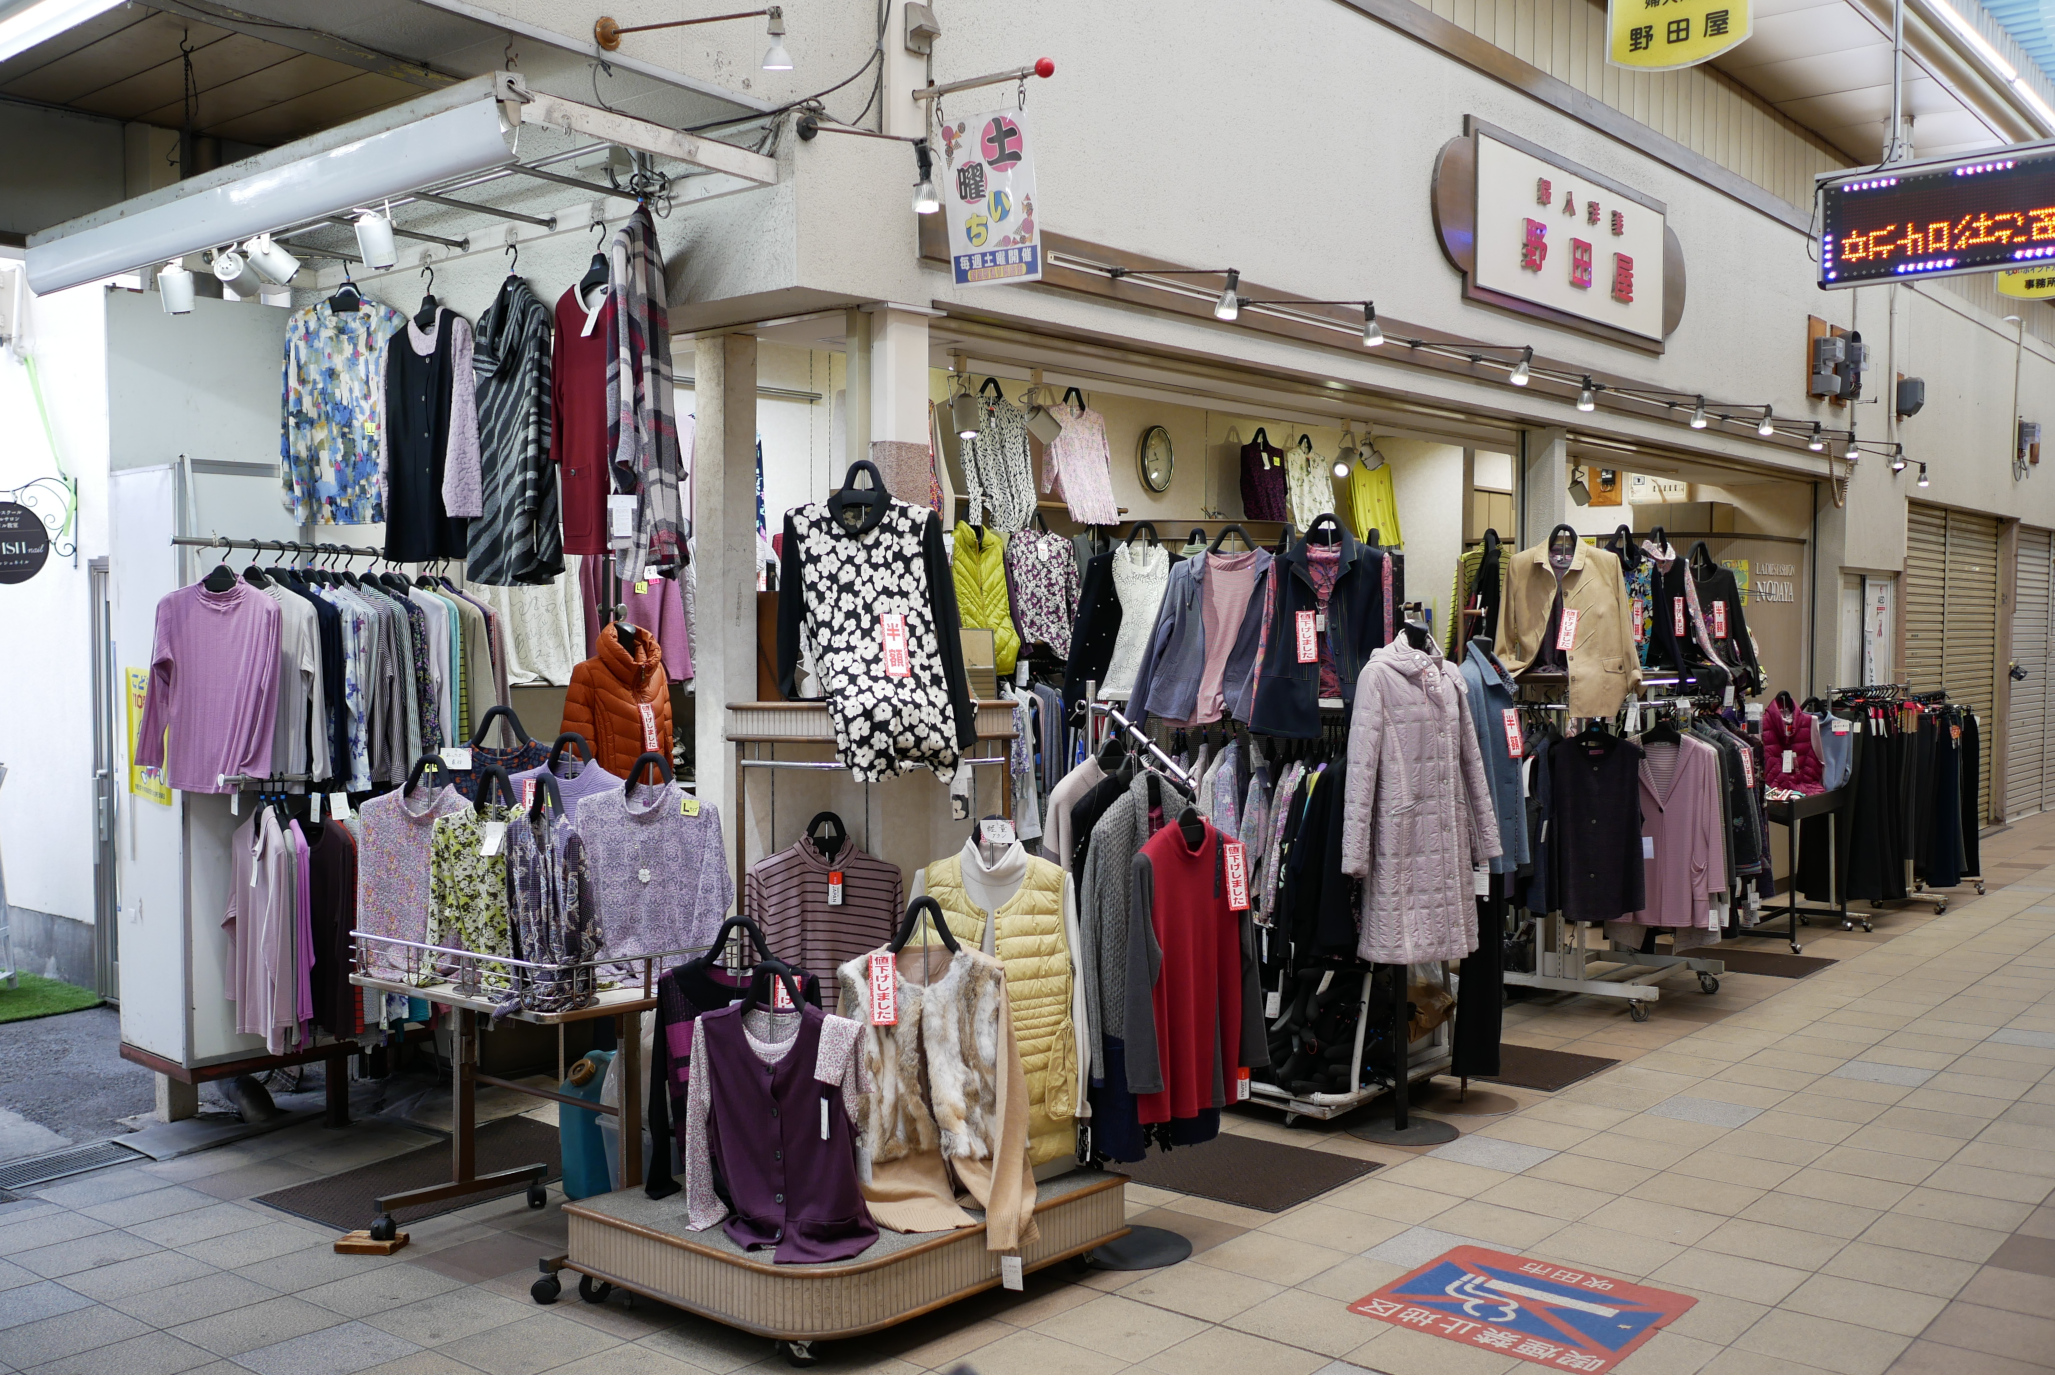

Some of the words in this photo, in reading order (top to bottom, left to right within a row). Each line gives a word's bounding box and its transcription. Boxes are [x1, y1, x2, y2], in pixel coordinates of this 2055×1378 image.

[1629, 9, 1729, 53] 野田屋
[960, 246, 1033, 271] 毎週土曜開催
[1520, 217, 1634, 303] 野田屋
[1755, 580, 1794, 603] NODAYA
[1300, 613, 1313, 659] 値下げしました
[1560, 609, 1577, 650] 値下げしました
[1715, 605, 1724, 633] 半額
[886, 622, 905, 668] 半額
[641, 705, 657, 748] 値下げしました
[1506, 714, 1520, 751] 半額
[1228, 846, 1245, 906] 値下げしました
[874, 955, 891, 1021] 値下げしました
[1517, 1261, 1615, 1291] 吹田市
[1356, 1297, 1607, 1373] 喫煙禁止地区
